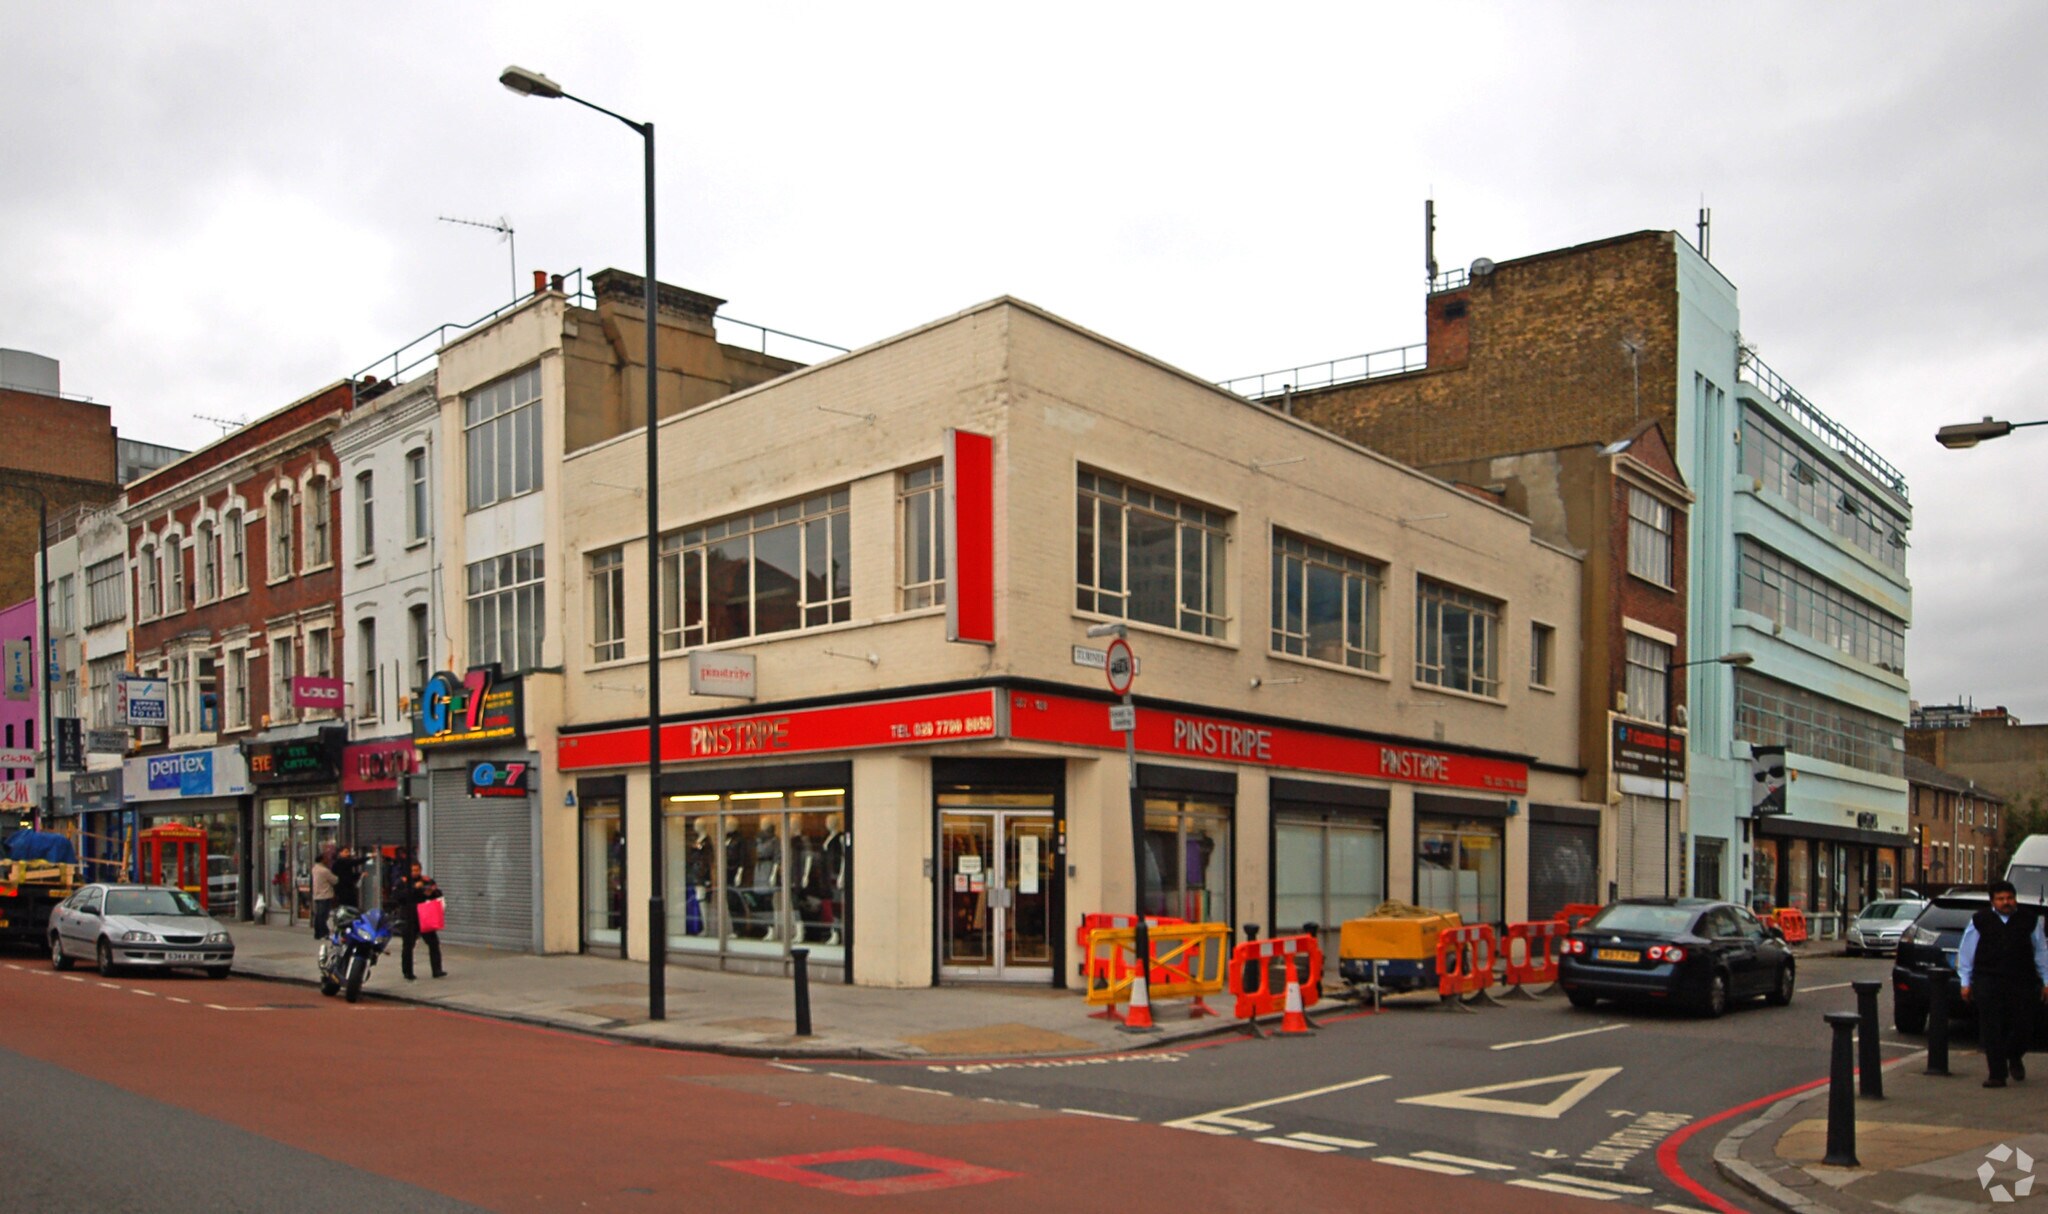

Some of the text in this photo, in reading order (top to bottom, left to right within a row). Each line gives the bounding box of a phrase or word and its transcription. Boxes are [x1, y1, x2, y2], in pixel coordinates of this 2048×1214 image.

[13, 651, 25, 693] rise
[701, 664, 751, 681] pinstripe
[300, 687, 339, 699] LOUD
[691, 718, 790, 755] PINSTRIPE
[890, 724, 911, 738] TEL
[1174, 718, 1272, 760] PINSTRIPE
[150, 756, 206, 781] pentex
[251, 755, 273, 772] EYE
[472, 762, 526, 787] G-7
[1380, 747, 1449, 781] PINSTRIPE
